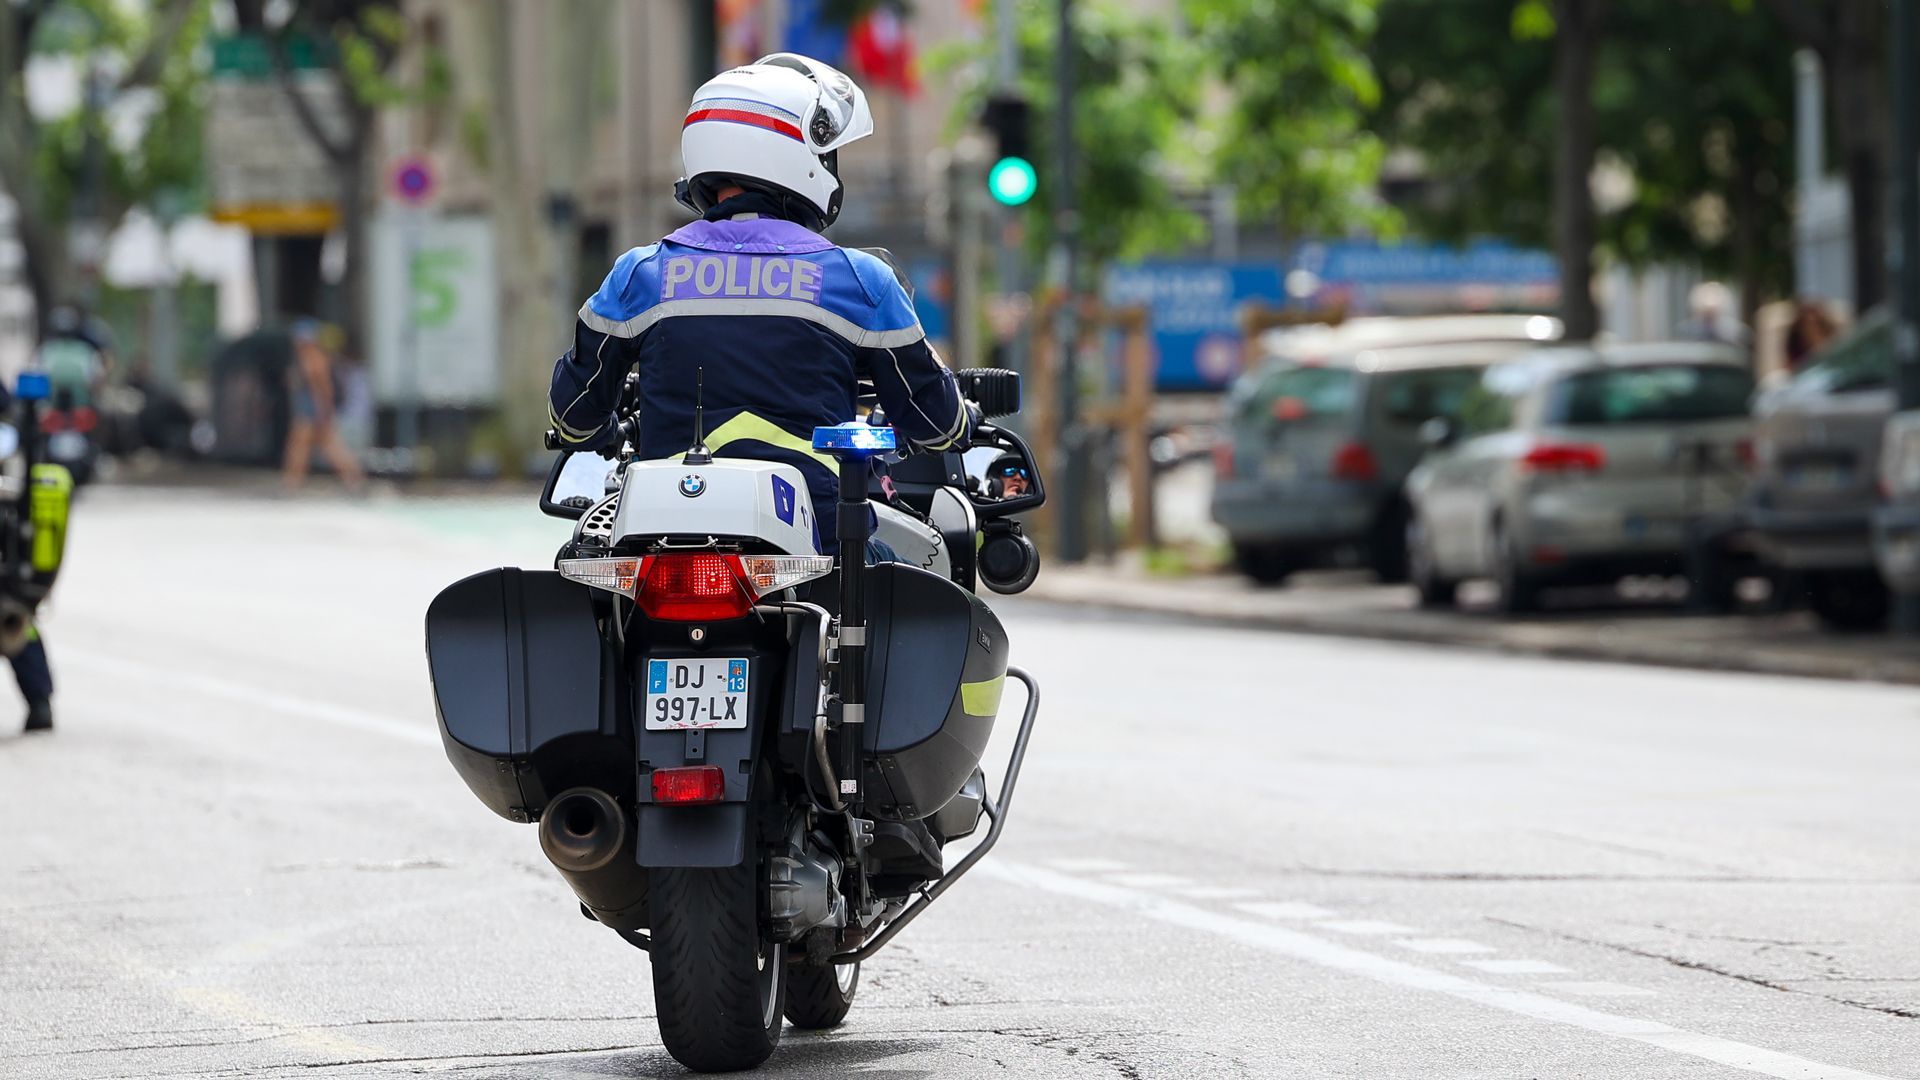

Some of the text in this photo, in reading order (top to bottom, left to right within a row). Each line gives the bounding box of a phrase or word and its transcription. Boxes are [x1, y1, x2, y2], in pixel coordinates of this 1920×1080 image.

[665, 255, 817, 301] POLICE
[654, 680, 662, 689] F
[675, 665, 705, 689] DJ
[729, 677, 745, 690] 13
[655, 696, 738, 722] 997-LX
